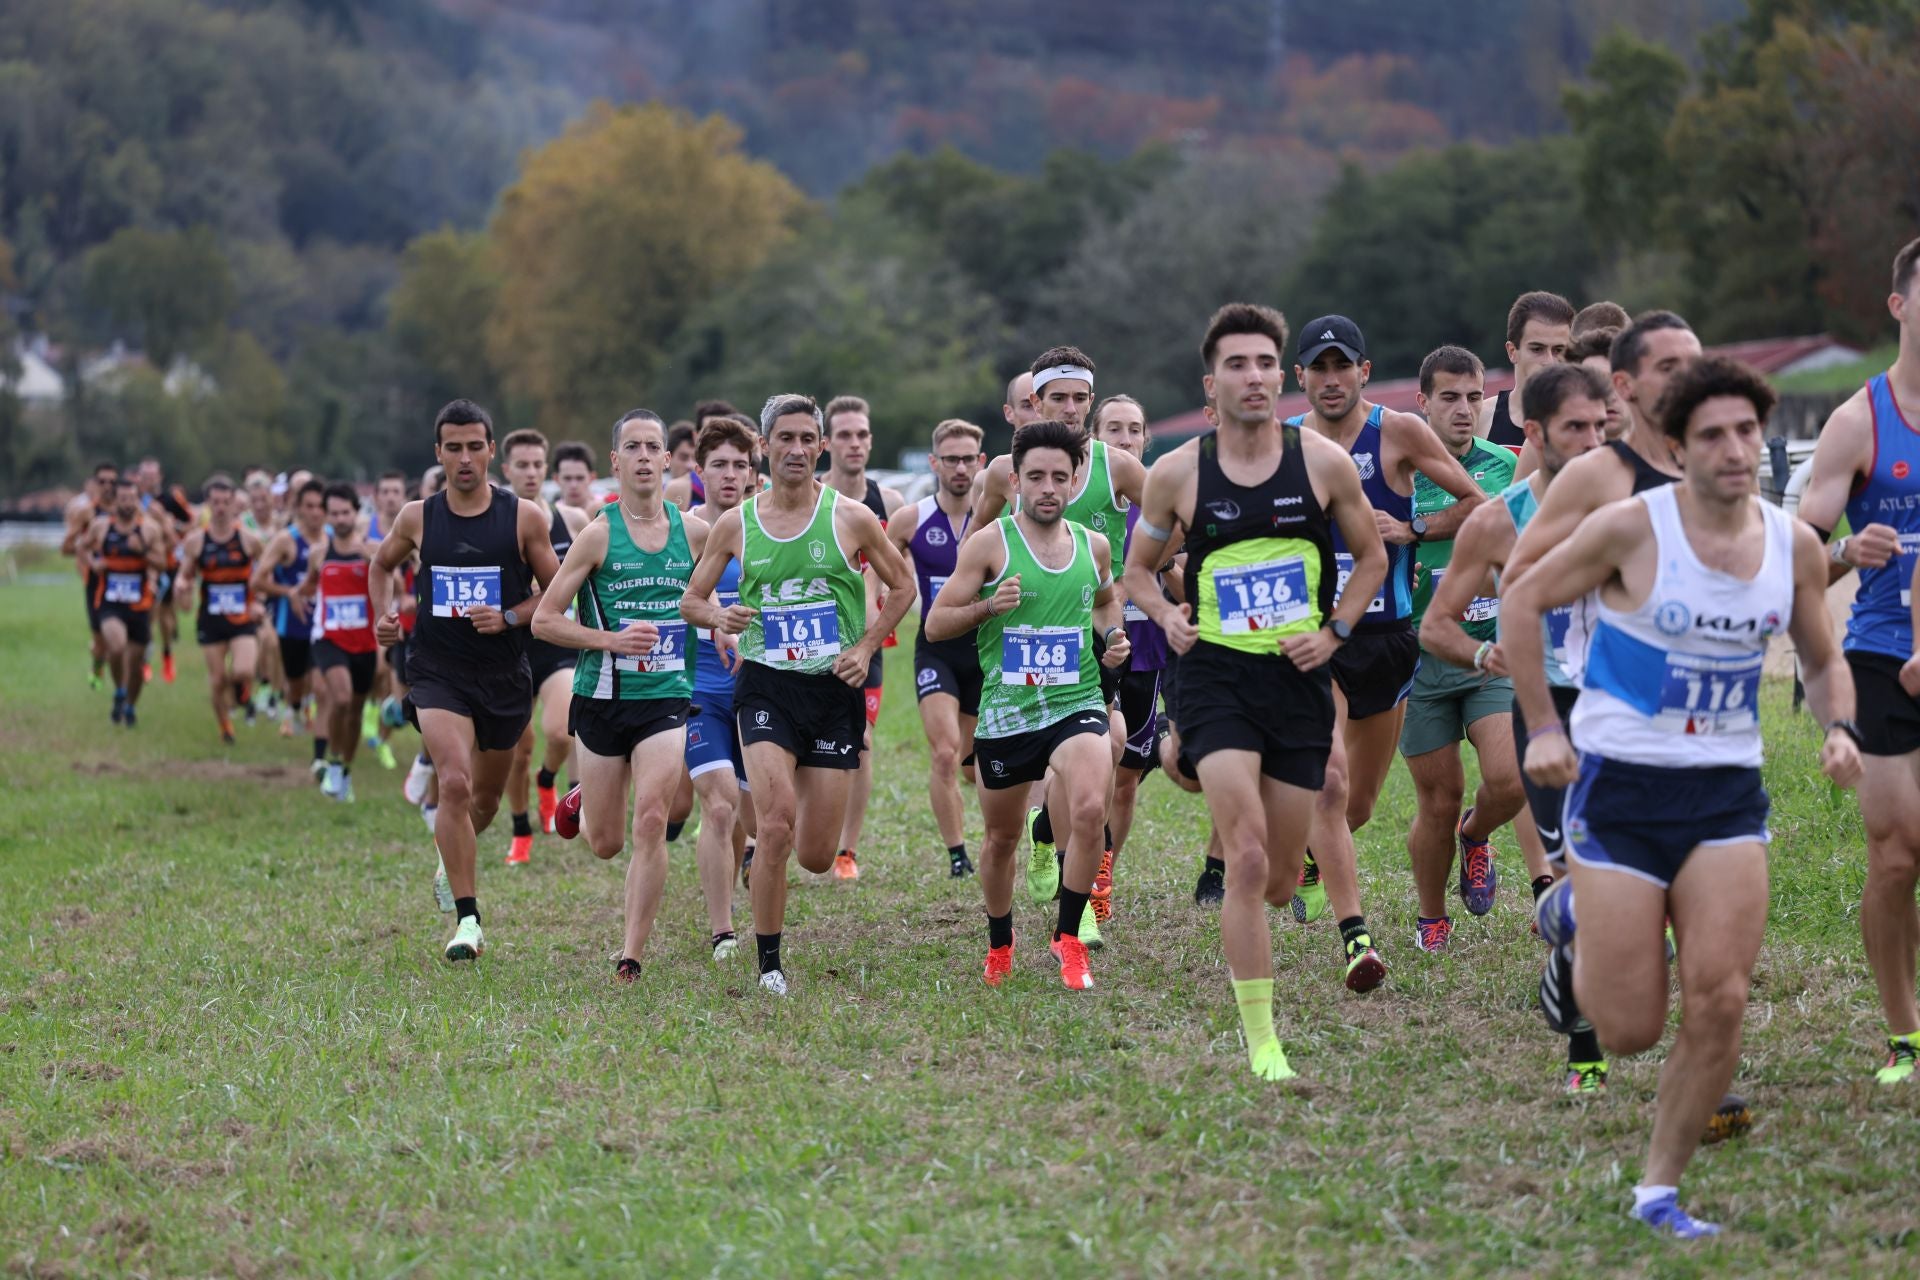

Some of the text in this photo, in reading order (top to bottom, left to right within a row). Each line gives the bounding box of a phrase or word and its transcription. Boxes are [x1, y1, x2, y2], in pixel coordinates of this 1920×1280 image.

[445, 581, 488, 600] 156
[656, 577, 688, 591] GARAI
[761, 577, 832, 603] LEA
[1235, 577, 1292, 610] 126
[778, 618, 822, 642] 161
[1695, 614, 1755, 632] KIA
[650, 634, 675, 655] 46
[1020, 644, 1067, 666] 168
[1685, 680, 1744, 711] 116
[815, 739, 836, 751] Vital
